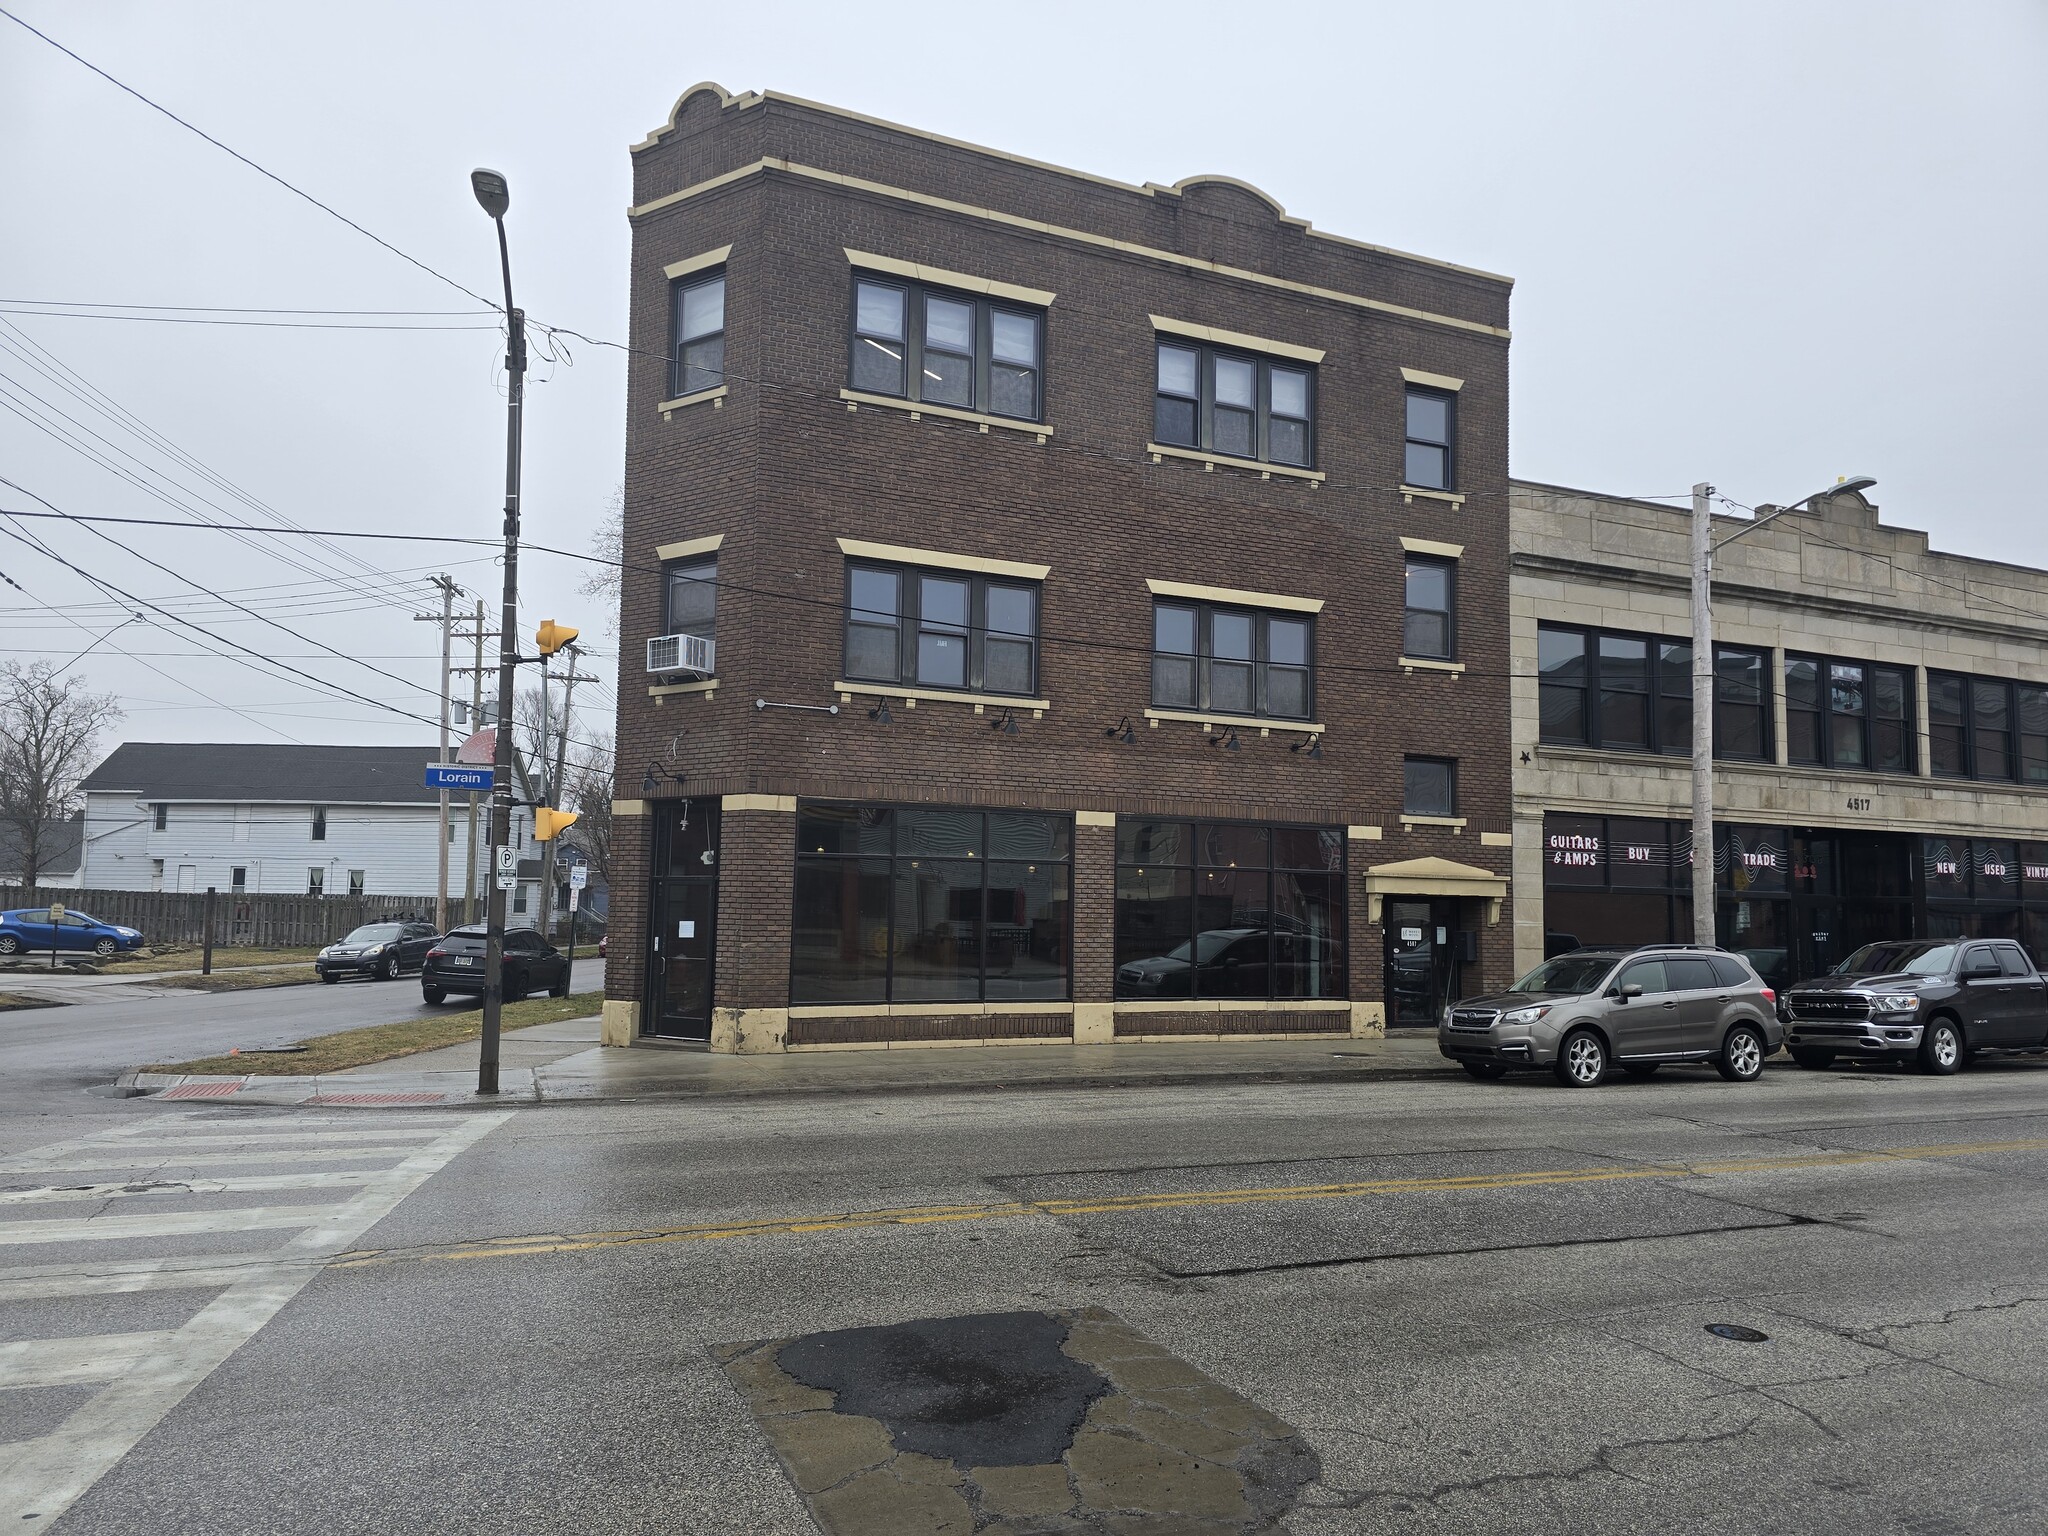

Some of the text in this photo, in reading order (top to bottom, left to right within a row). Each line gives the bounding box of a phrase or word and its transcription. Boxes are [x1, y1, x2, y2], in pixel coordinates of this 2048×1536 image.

[438, 771, 481, 783] Lorain
[1846, 797, 1871, 811] 4517
[1550, 834, 1599, 850] GUITARS
[504, 853, 511, 865] P
[1553, 851, 1597, 866] & AMPS
[1628, 847, 1650, 861] BUY
[1743, 853, 1776, 866] TRADE
[1936, 862, 1956, 874] NEW
[1984, 863, 2006, 876] USED
